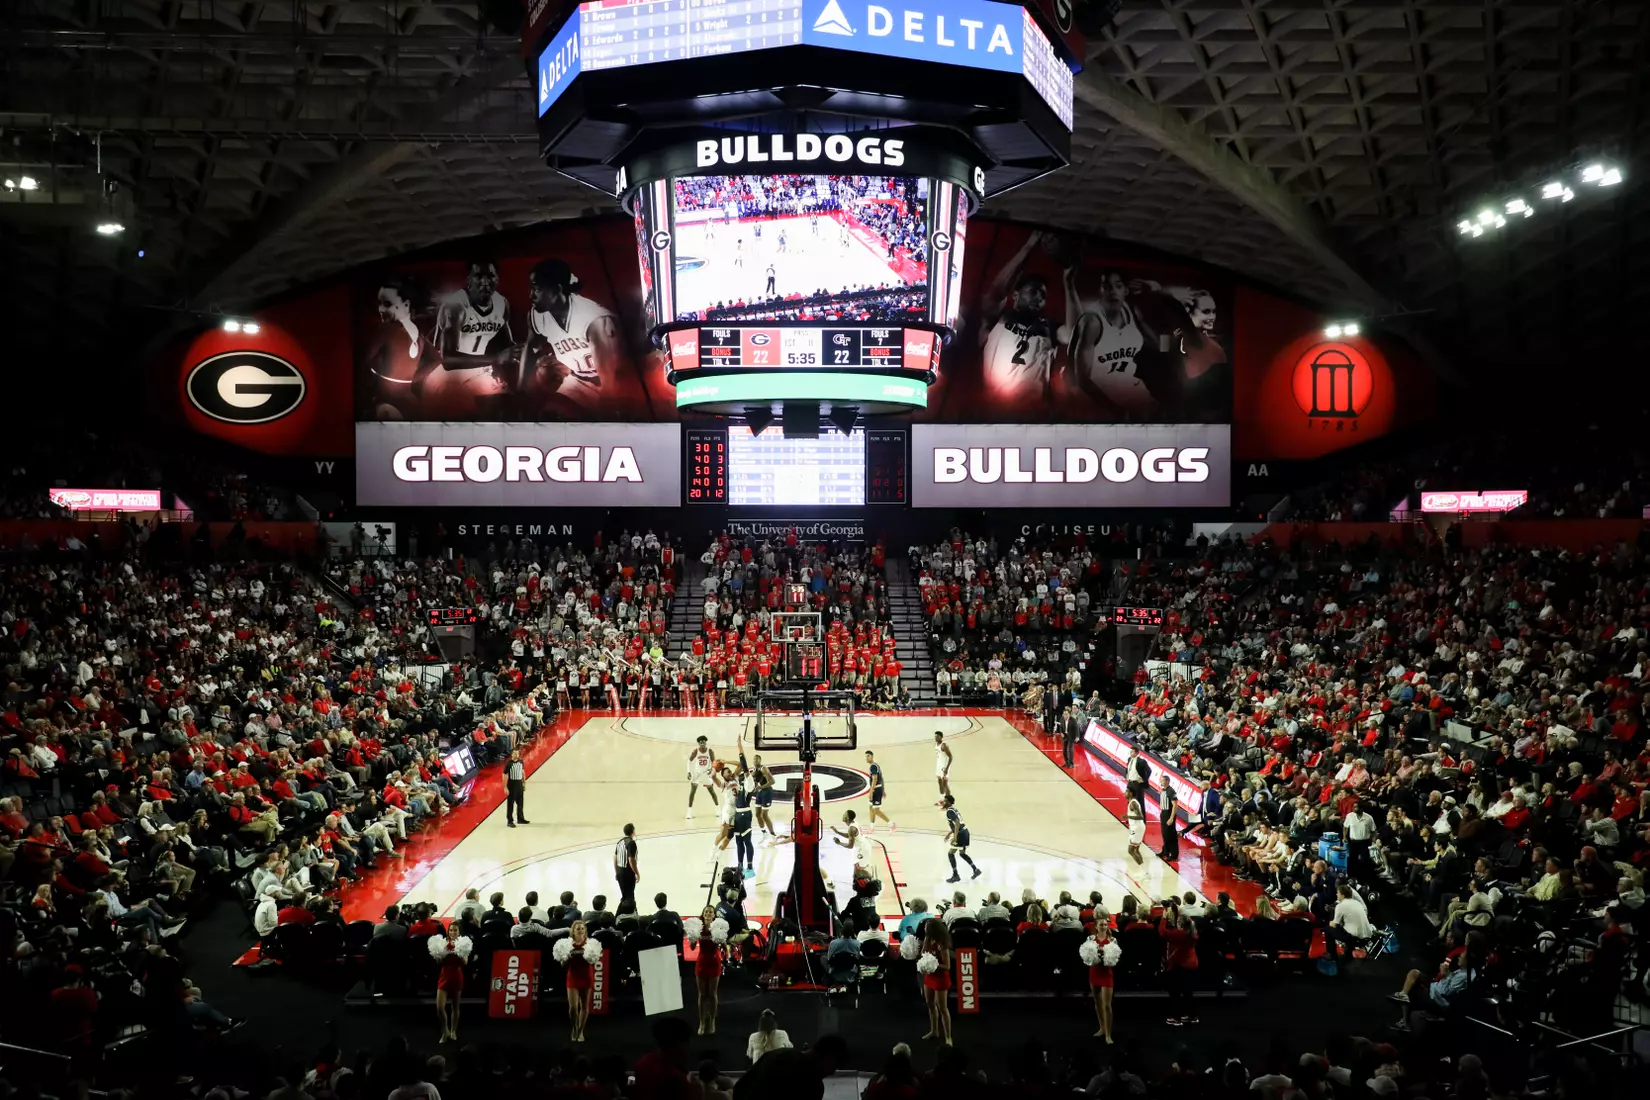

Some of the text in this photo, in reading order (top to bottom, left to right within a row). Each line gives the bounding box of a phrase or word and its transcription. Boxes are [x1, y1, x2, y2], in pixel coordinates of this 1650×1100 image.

[704, 19, 728, 30] Wright
[866, 4, 1014, 56] DELTA
[592, 32, 623, 45] Edwards
[550, 32, 578, 89] DELTA
[697, 134, 904, 167] BULLDOGS
[472, 336, 482, 352] 1
[753, 350, 768, 364] 22
[788, 353, 815, 364] 5:35
[835, 350, 849, 364] 22
[1011, 340, 1030, 365] 2
[696, 444, 723, 452] 3 0 0
[392, 445, 644, 483] GEORGIA
[695, 455, 723, 463] 4 0 3
[933, 448, 1210, 483] BULLDOGS
[315, 462, 334, 474] YY
[695, 467, 723, 475] 5 0 2
[1248, 464, 1269, 476] AA
[693, 478, 723, 486] 14 0 0
[690, 490, 701, 498] 20
[716, 490, 723, 498] 12
[458, 524, 572, 535] STEEMAN
[728, 523, 750, 534] The
[806, 523, 820, 534] of
[820, 523, 864, 538] Georgia
[793, 593, 803, 602] 11
[505, 955, 519, 1014] STAND
[518, 972, 529, 997] UP
[594, 954, 603, 1010] OUDER
[961, 952, 974, 1009] NOISE
